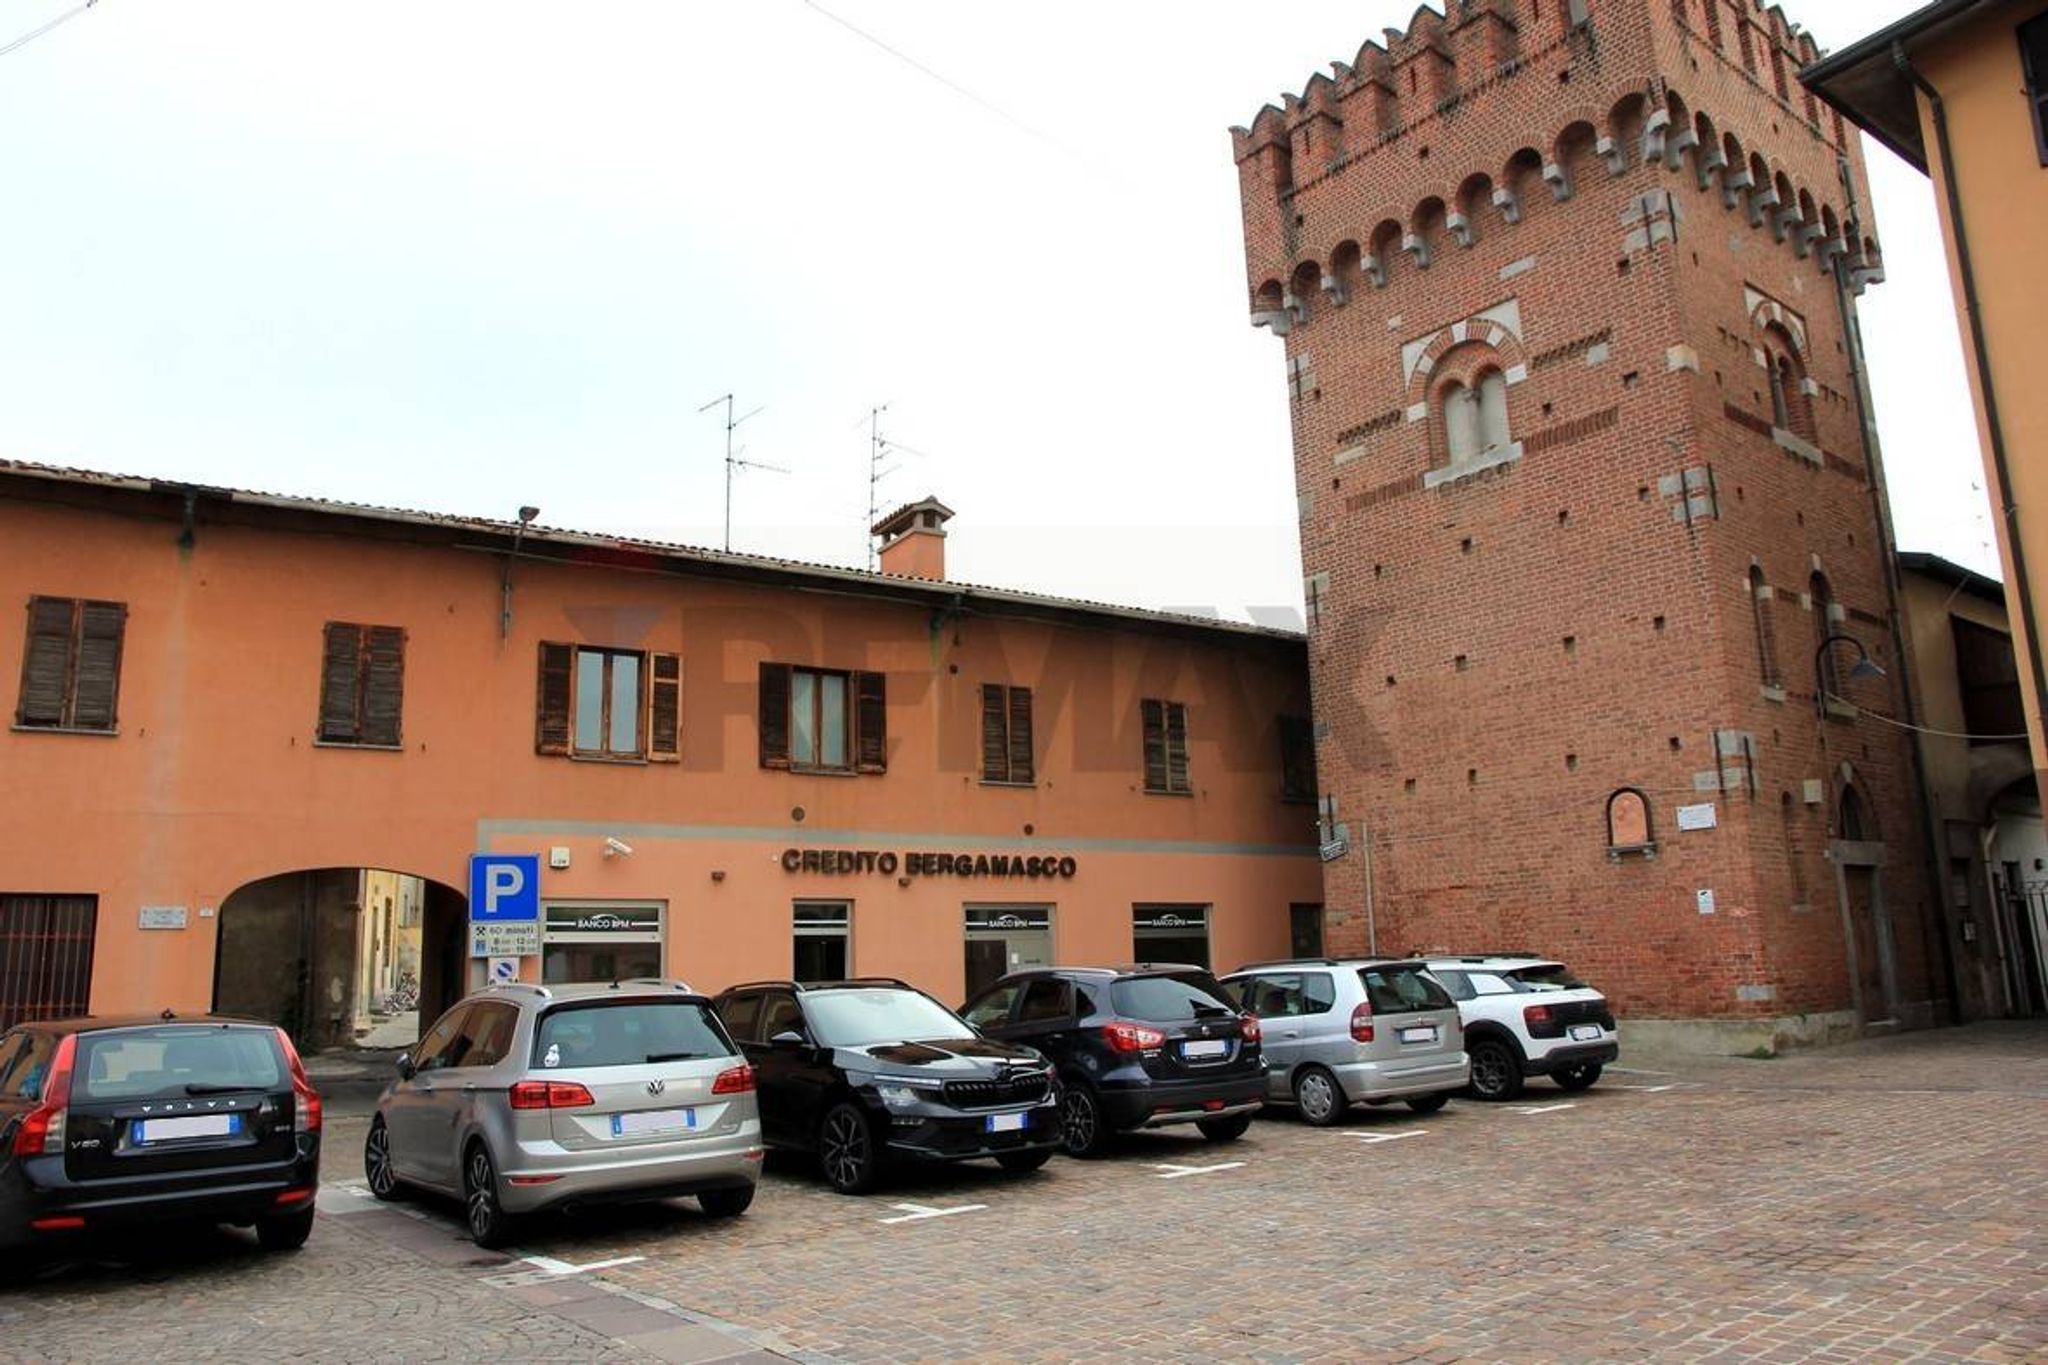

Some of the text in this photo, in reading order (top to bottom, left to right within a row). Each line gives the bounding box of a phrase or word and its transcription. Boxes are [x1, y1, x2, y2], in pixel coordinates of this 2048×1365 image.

[782, 848, 1077, 878] CREDITO BERGAMASCO
[486, 863, 524, 914] P
[578, 919, 630, 929] BANCO BPM
[505, 925, 534, 935] minuti
[142, 1101, 236, 1112] VOLVO
